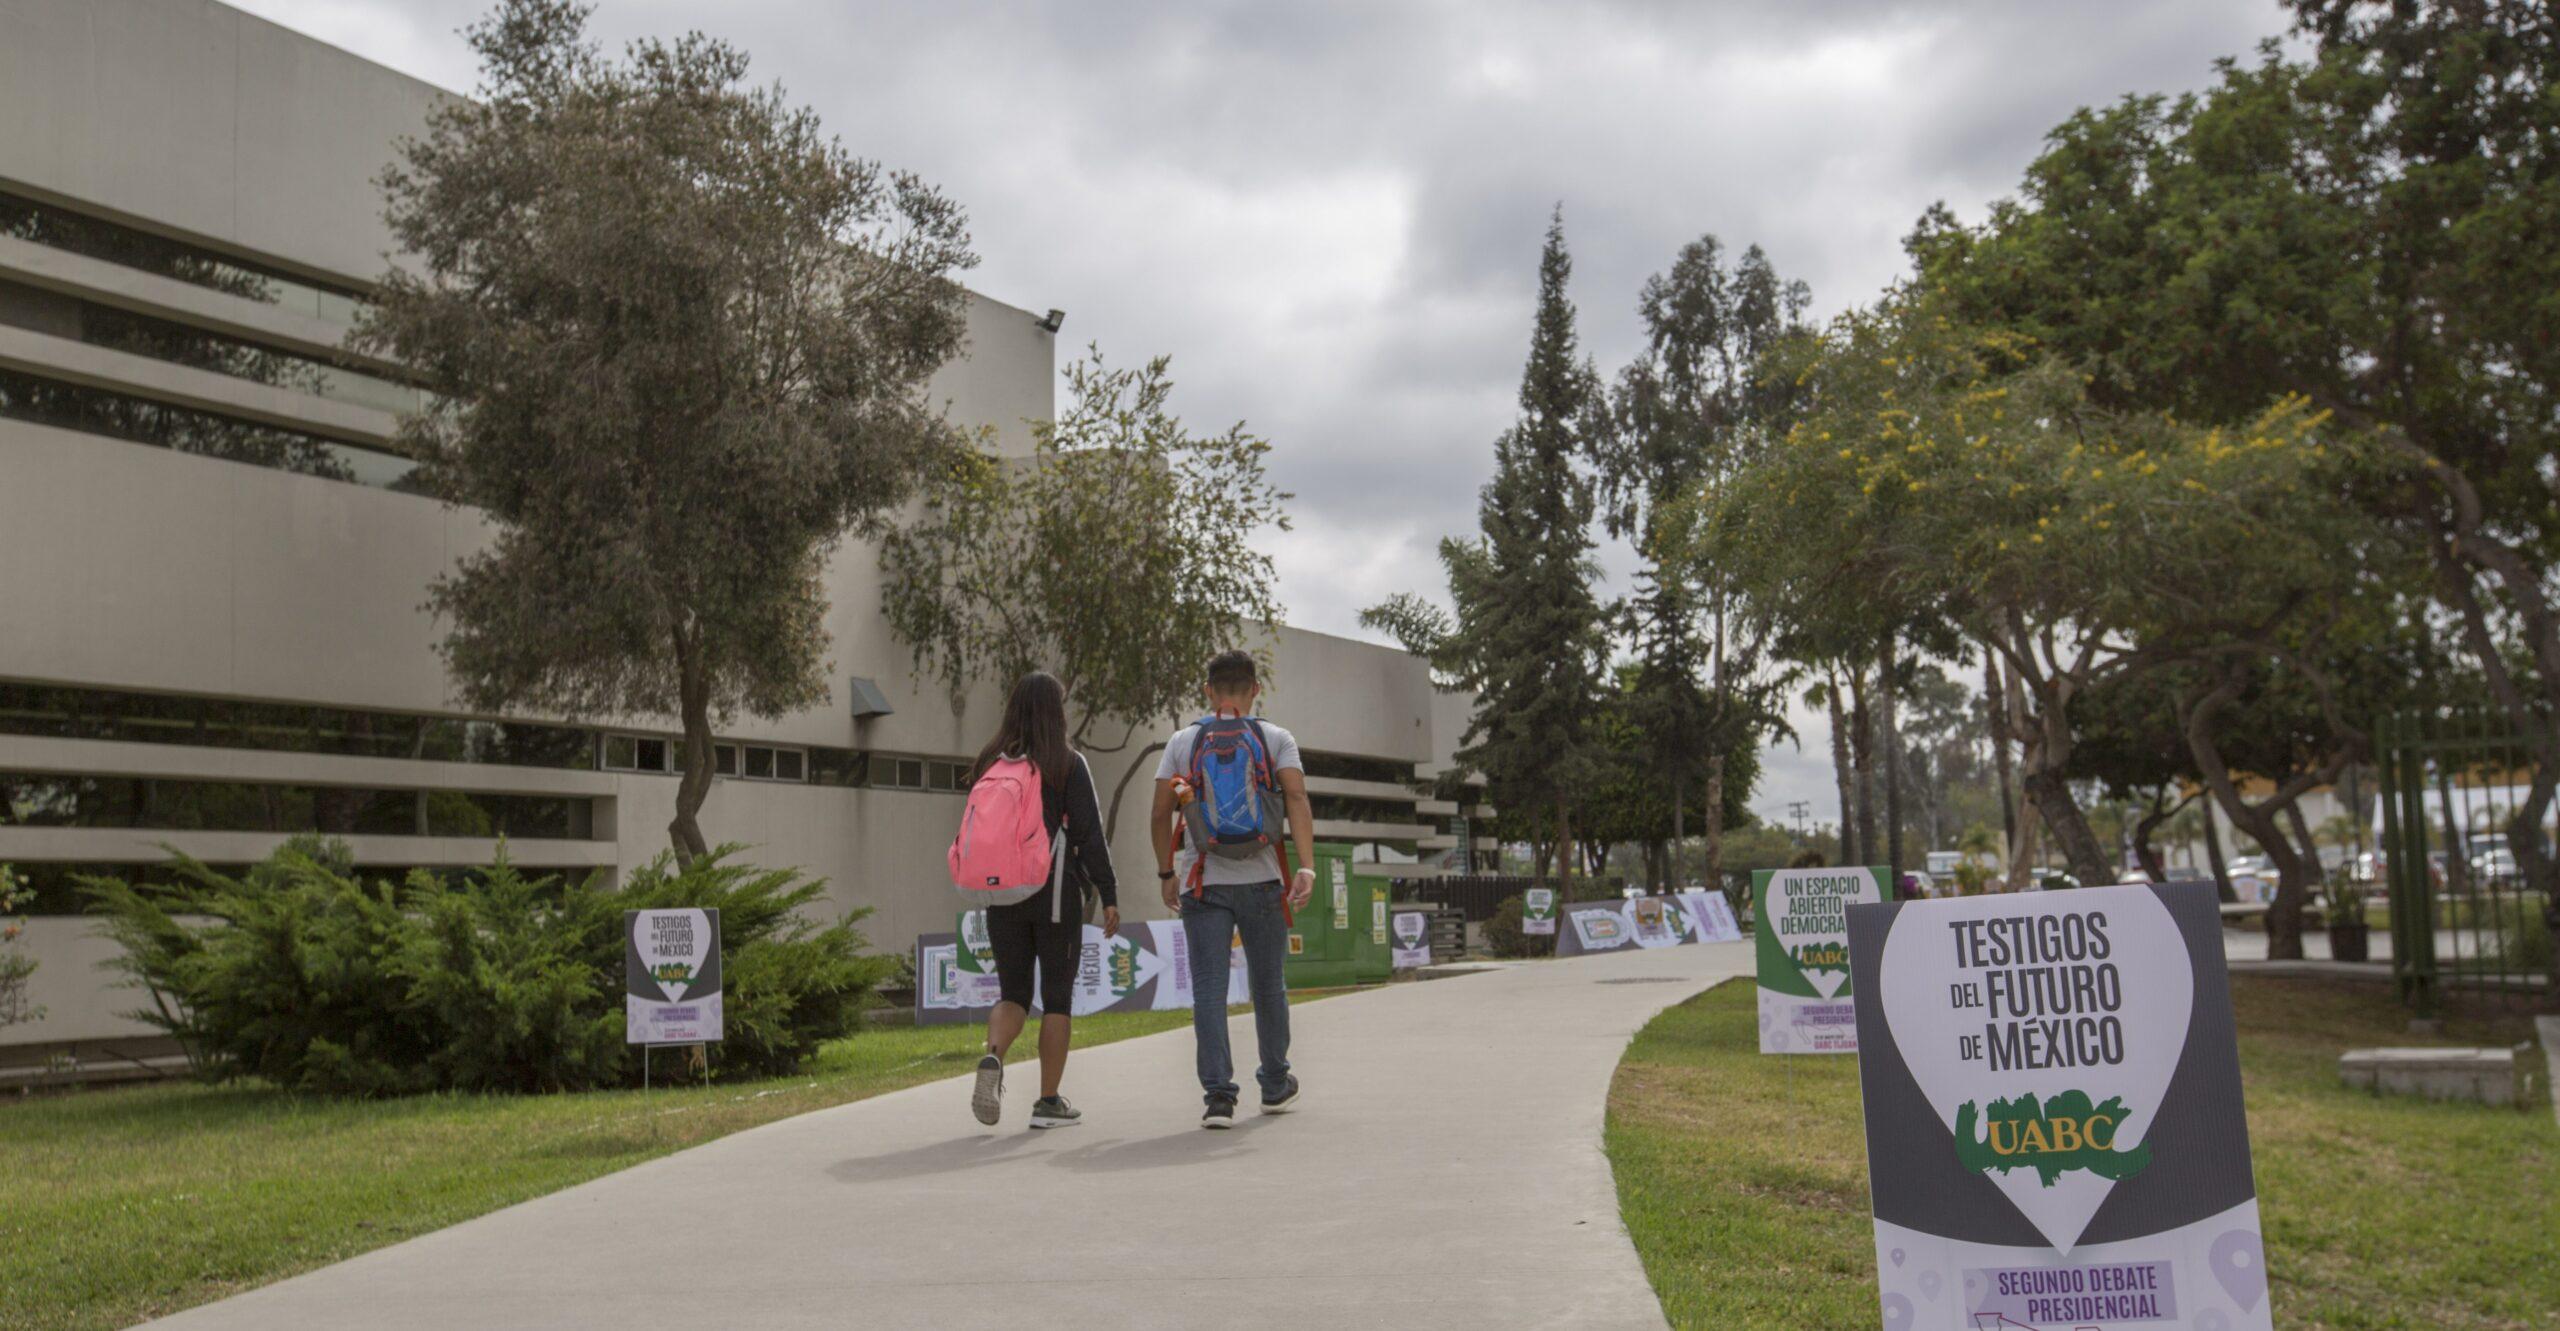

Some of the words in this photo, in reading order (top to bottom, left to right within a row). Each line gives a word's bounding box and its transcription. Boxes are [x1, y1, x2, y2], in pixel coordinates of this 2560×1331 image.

[1784, 877, 1803, 897] UN
[1806, 875, 1860, 895] ESPACIO
[1788, 895, 1842, 915] ABIERTO
[652, 915, 691, 930] TESTIGOS
[659, 930, 694, 943] FUTURO
[1949, 911, 2111, 969] TESTIGOS
[1080, 942, 1101, 987] MÉXICO
[1117, 949, 1132, 987] UABC
[1802, 950, 1849, 965] UABC
[1950, 982, 1984, 1009] DEL
[1986, 962, 2122, 1019] FUTURO
[1960, 1034, 1983, 1061] DE
[1986, 1015, 2124, 1072] MÉXICO
[1986, 1115, 2115, 1156] UABC
[1997, 1268, 2084, 1296] SEGUNDO
[2089, 1266, 2157, 1293] DEBATE
[2027, 1293, 2162, 1322] PRESIDENCIAL
